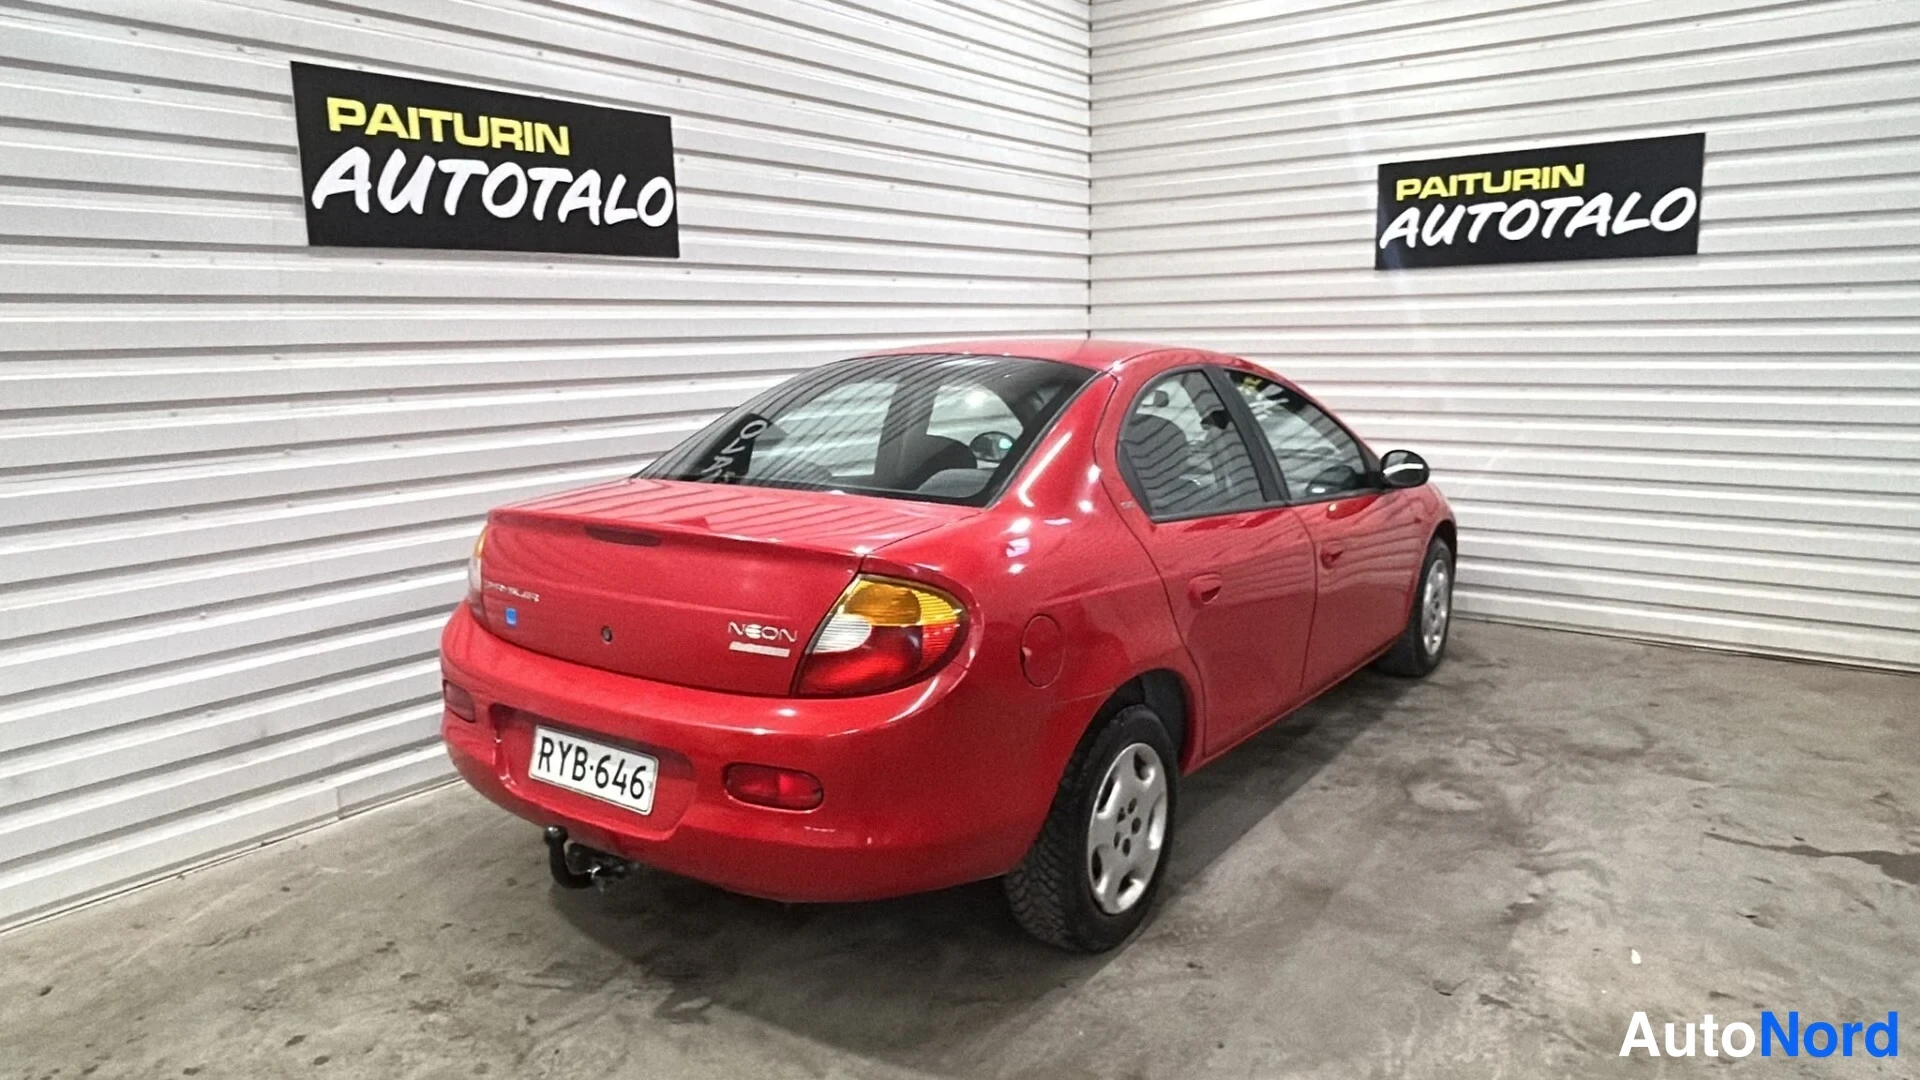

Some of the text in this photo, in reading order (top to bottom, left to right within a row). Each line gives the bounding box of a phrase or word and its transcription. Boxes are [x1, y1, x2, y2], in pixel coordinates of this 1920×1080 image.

[327, 97, 570, 156] PAITURIN
[312, 146, 674, 227] AUTOTALO
[1396, 164, 1585, 201] PAITURIN
[1379, 187, 1697, 249] AUTOTALO
[728, 621, 798, 642] NEON
